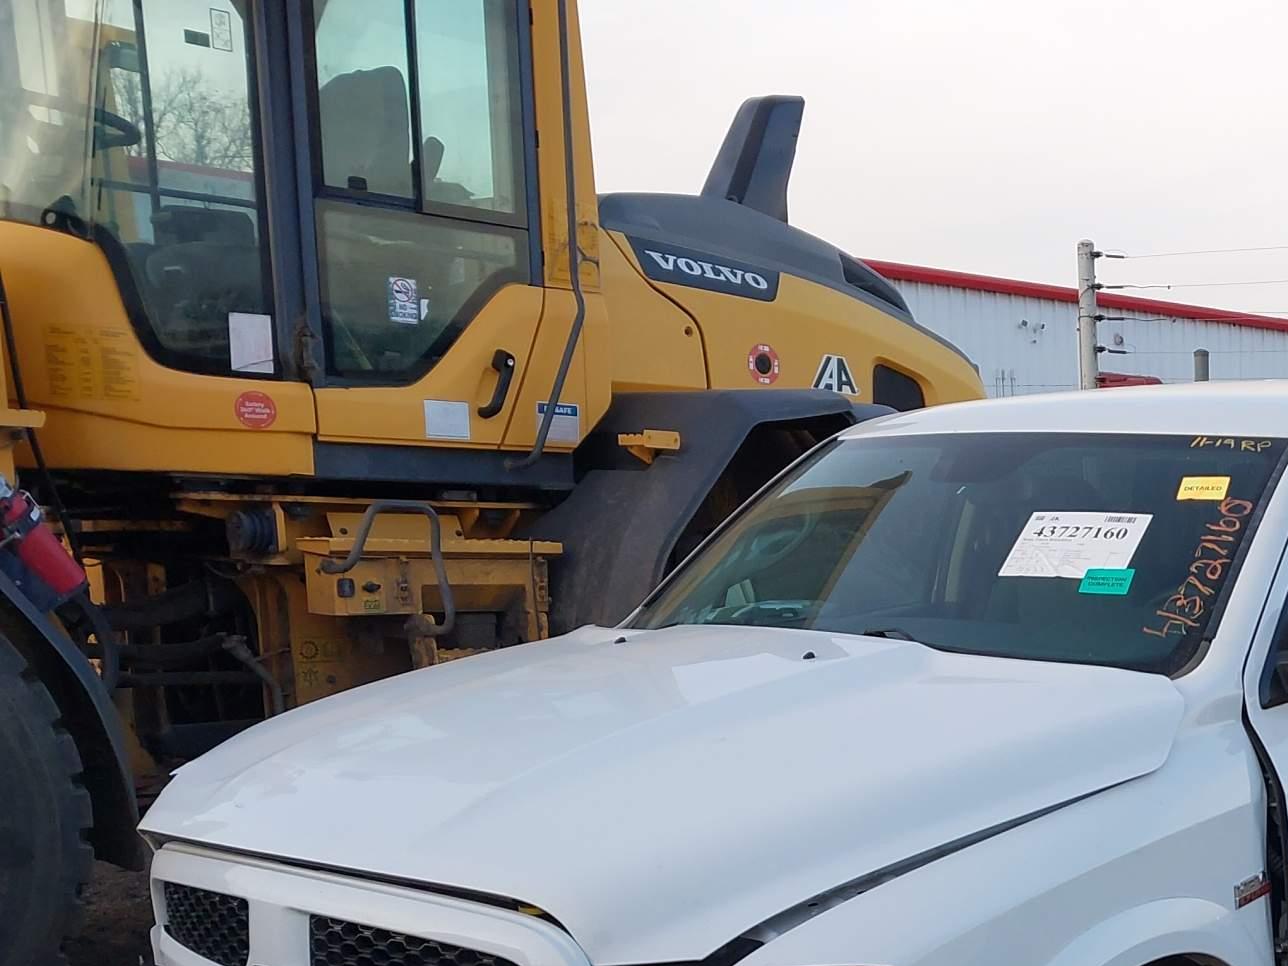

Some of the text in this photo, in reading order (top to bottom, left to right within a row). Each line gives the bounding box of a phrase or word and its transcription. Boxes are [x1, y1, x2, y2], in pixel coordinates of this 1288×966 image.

[644, 250, 768, 289] VOLVO
[1033, 526, 1129, 540] 43727160
[1143, 496, 1253, 638] 43727160
